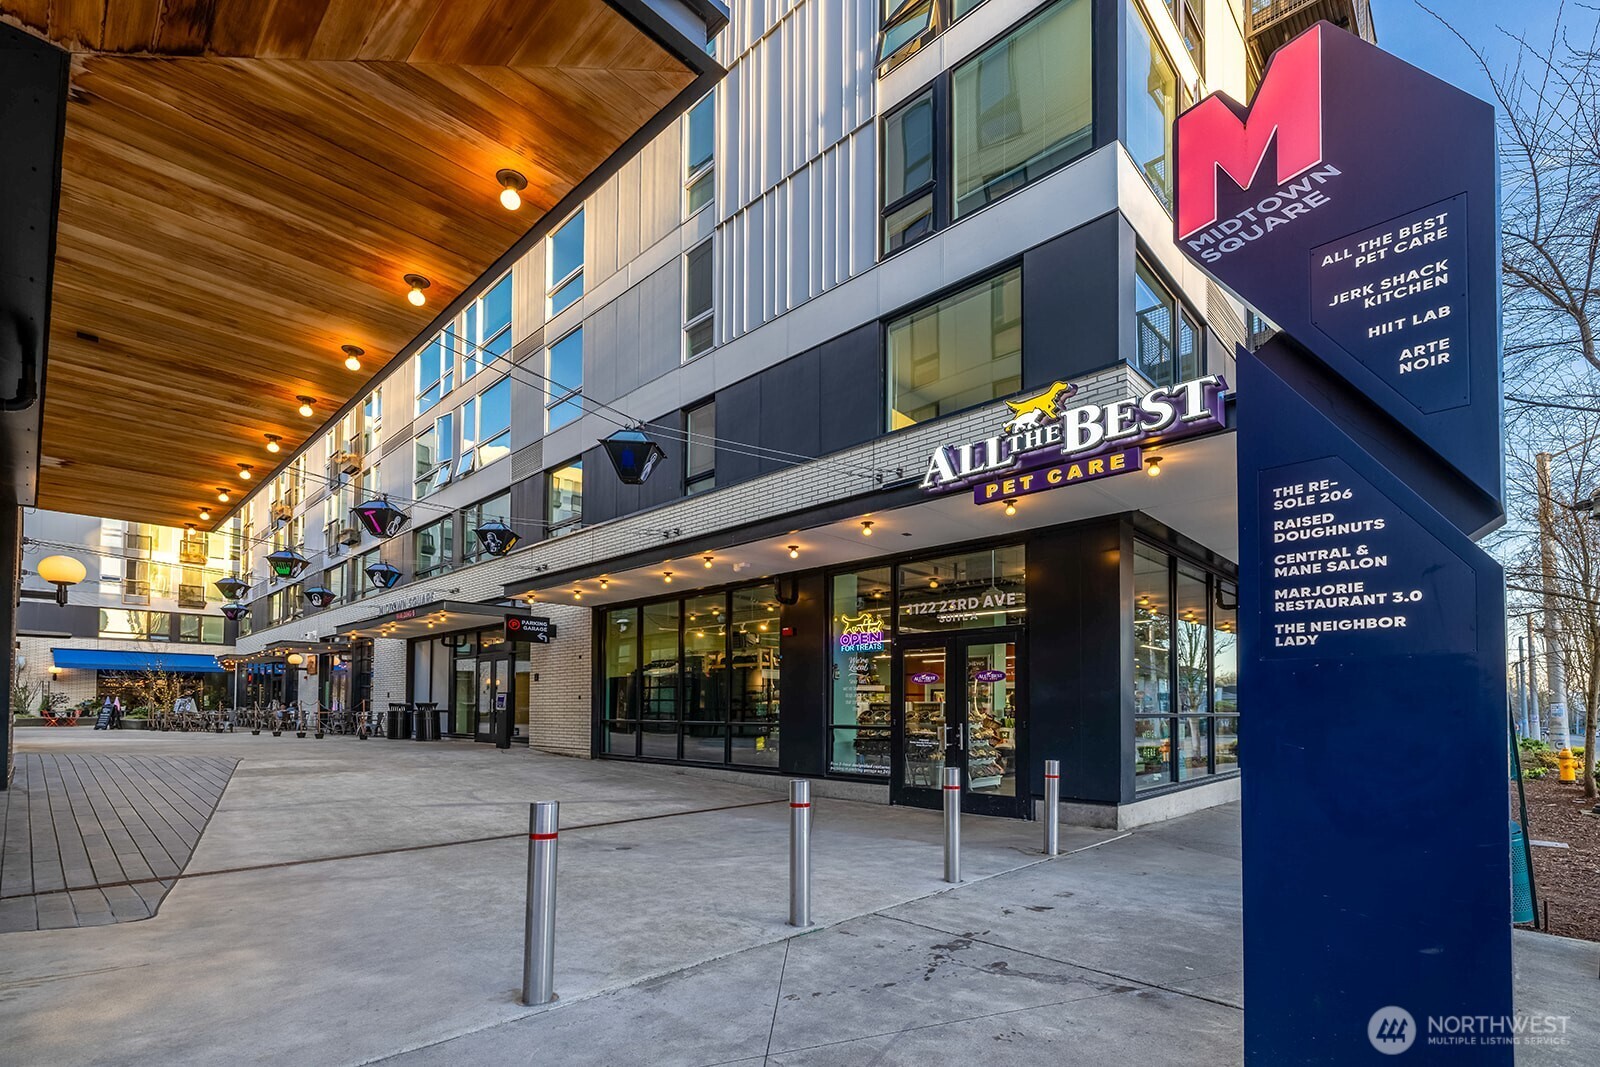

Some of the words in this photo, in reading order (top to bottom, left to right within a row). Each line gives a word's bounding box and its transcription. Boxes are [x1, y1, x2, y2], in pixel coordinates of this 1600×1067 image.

[1186, 163, 1342, 253] MIDTOWN
[1200, 190, 1332, 264] SQUARE
[1320, 247, 1353, 267] ALL
[1357, 234, 1393, 255] THE
[1399, 212, 1448, 242] BEST
[1354, 250, 1391, 268] PET
[1394, 227, 1449, 255] CARE
[1328, 283, 1374, 307] JERK
[1380, 259, 1449, 290] SHACK
[1364, 273, 1449, 309] KITCHEN
[1368, 315, 1408, 339] HIIT
[1413, 305, 1452, 326] LAB
[1399, 337, 1450, 362] ARTE
[1399, 352, 1450, 374] NOIR
[919, 436, 1017, 489] ALL
[1007, 423, 1063, 455] THE
[1061, 374, 1223, 455] BEST
[985, 474, 1034, 499] PET
[1047, 453, 1126, 485] CARE
[1273, 482, 1304, 498] THE
[1308, 479, 1338, 492] RE-
[1273, 495, 1316, 511] SOLE
[1320, 488, 1353, 503] 206
[1274, 512, 1335, 531] RAISED
[1274, 518, 1385, 543] DOUGHNUTS
[1274, 546, 1351, 565] CENTRAL
[1356, 544, 1369, 556] &
[1274, 563, 1322, 578] MANE
[1326, 555, 1388, 572] SALON
[940, 597, 979, 612] 23RD
[982, 592, 1016, 608] AVE
[1274, 581, 1364, 600] MARJORIE
[1274, 592, 1387, 612] RESTAURANT
[1392, 590, 1423, 603] 3.0
[1275, 622, 1305, 635] THE
[1310, 616, 1407, 633] NEIGHBOR
[840, 632, 882, 647] OPEN
[856, 643, 882, 651] TREATS
[1275, 635, 1319, 647] LADY
